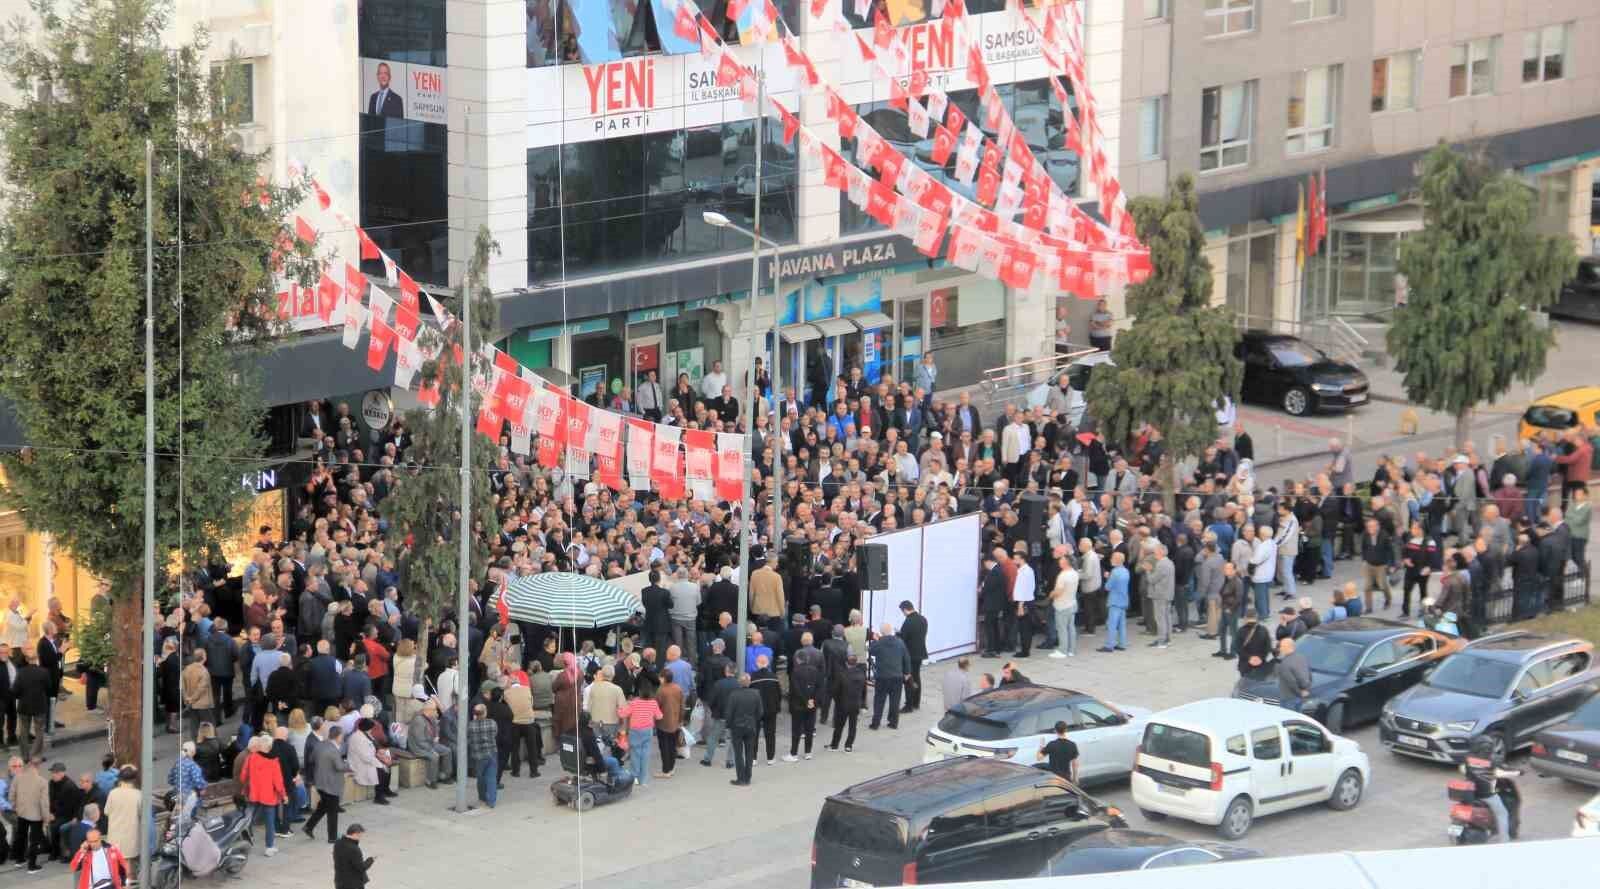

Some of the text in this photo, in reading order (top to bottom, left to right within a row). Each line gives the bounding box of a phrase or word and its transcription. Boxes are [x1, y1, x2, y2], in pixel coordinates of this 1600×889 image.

[985, 29, 1041, 50] SAMSU
[768, 252, 835, 279] HAVANA
[842, 242, 896, 267] PLAZA
